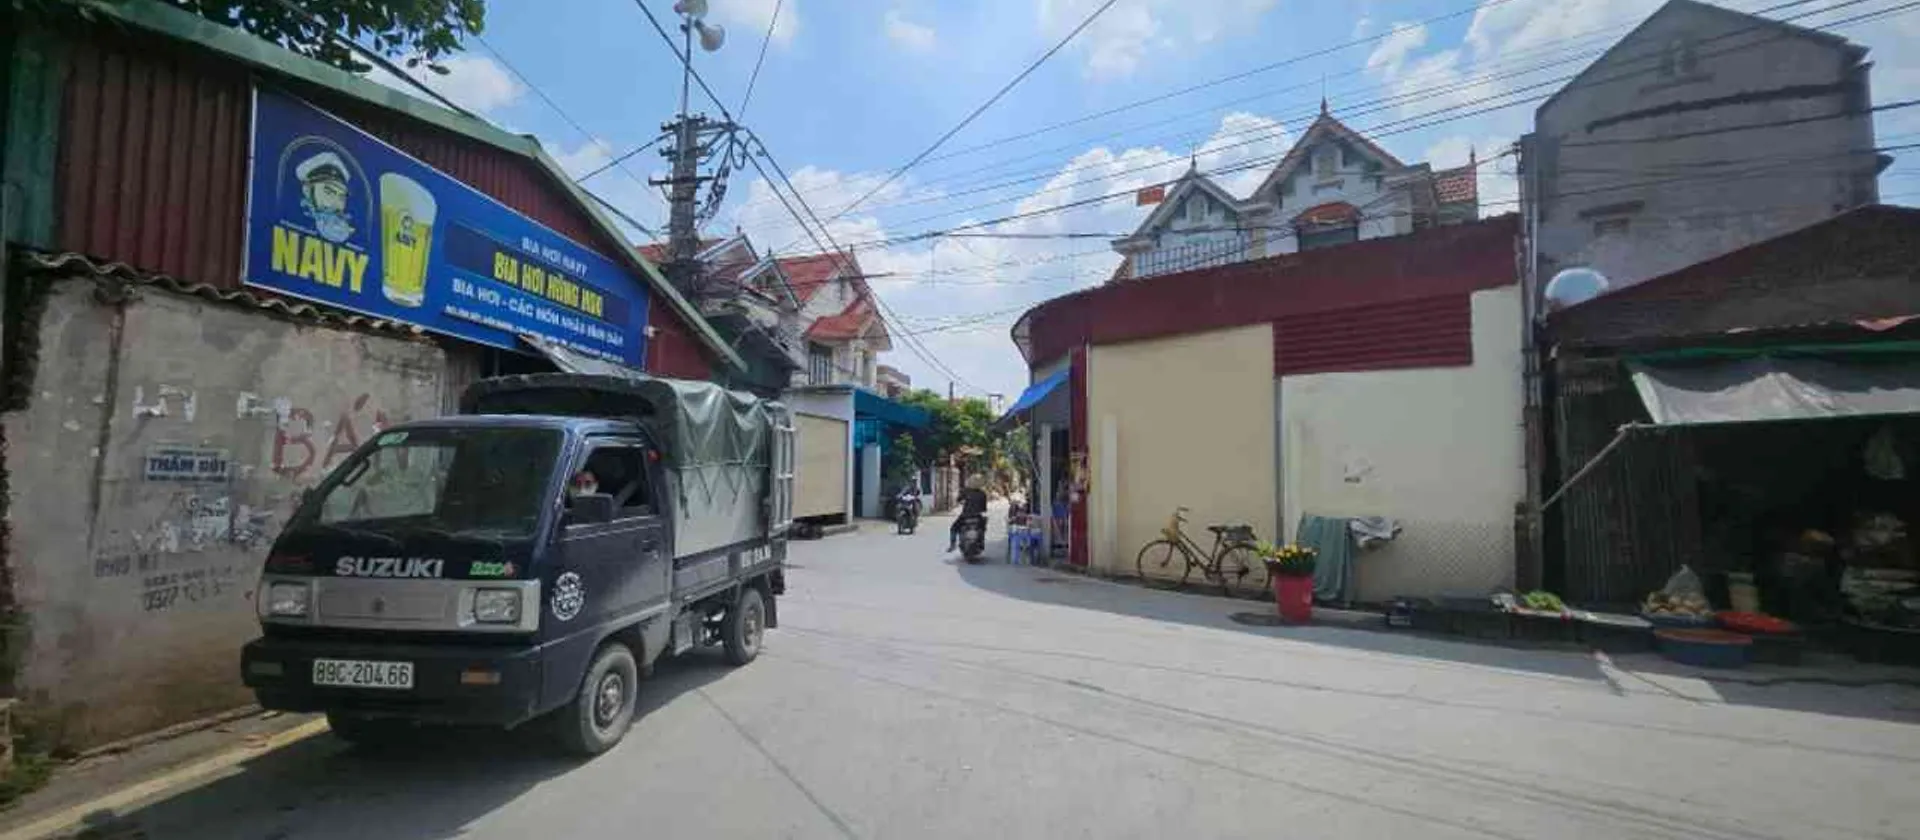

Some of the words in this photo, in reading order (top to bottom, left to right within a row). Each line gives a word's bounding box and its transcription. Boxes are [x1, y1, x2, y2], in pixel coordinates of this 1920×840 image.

[271, 225, 369, 293] NAVY
[522, 236, 540, 254] BIA
[493, 251, 518, 286] BIA
[452, 277, 474, 299] BIA
[508, 298, 534, 318] CÁC
[336, 556, 444, 578] SUZUKI
[315, 662, 411, 687] 89C-204.66
